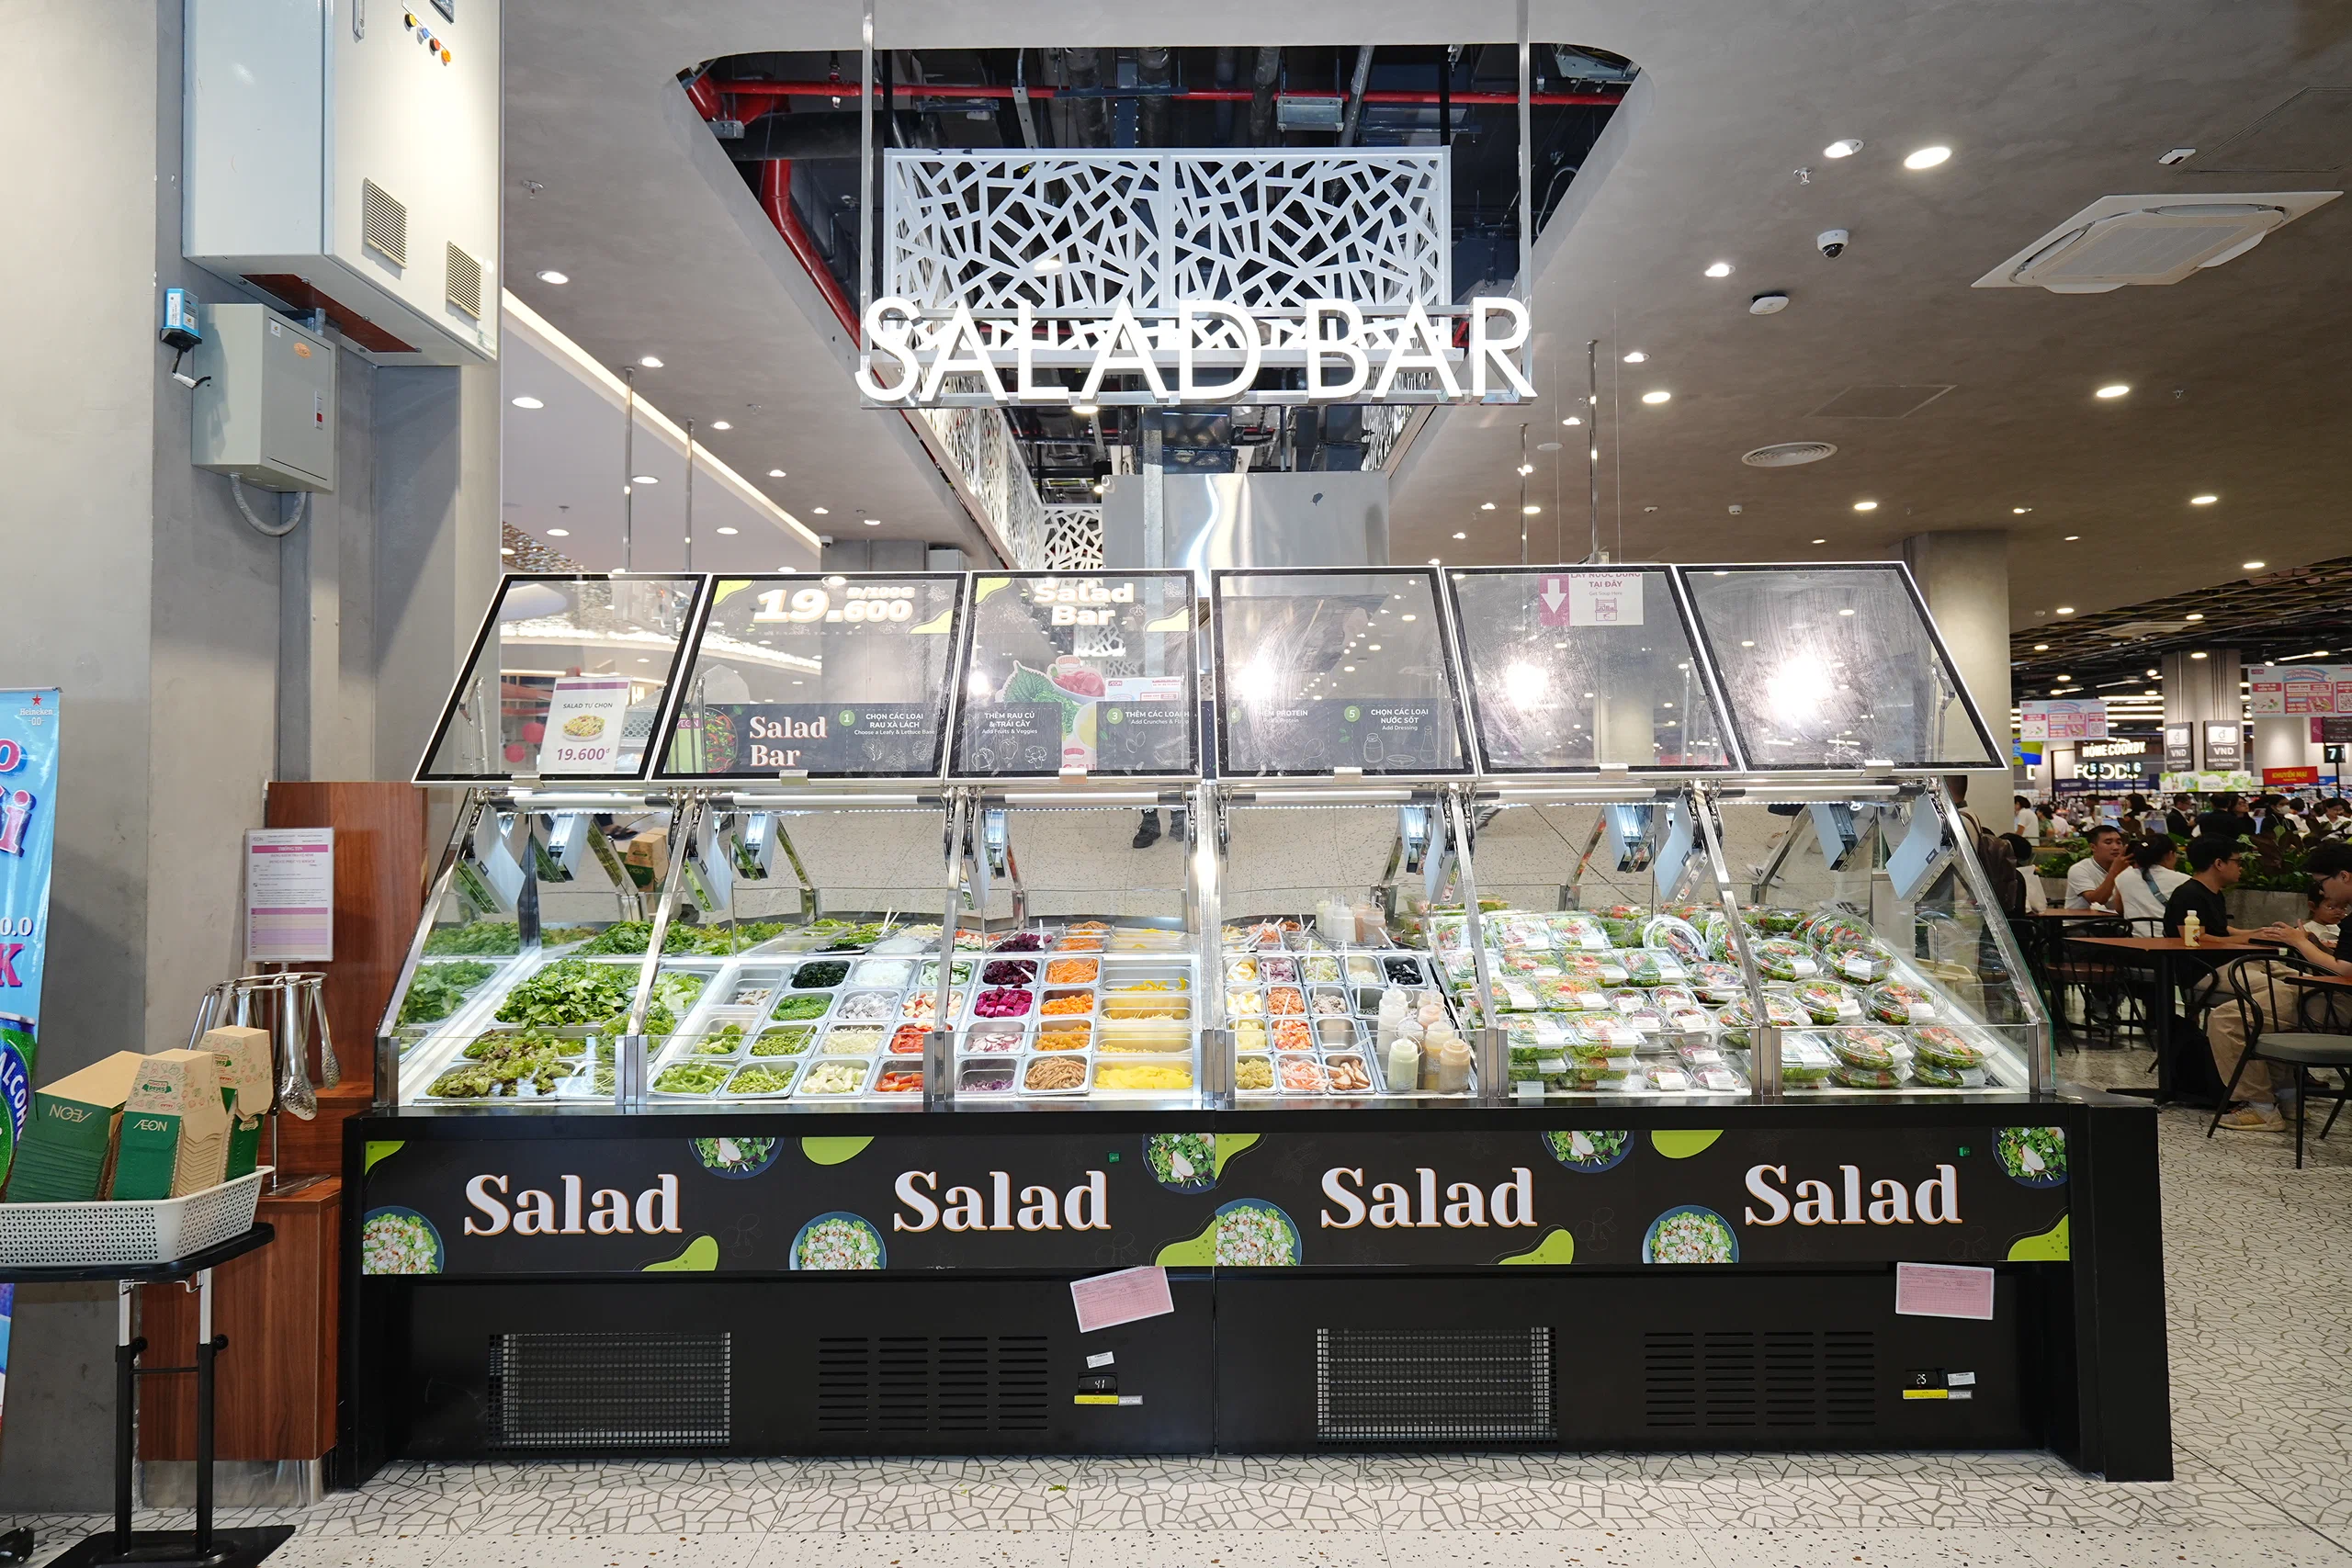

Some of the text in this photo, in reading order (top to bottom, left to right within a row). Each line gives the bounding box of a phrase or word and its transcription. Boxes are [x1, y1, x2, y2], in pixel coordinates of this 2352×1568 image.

[854, 296, 1539, 402] SALAD BAR
[1033, 578, 1134, 604] Salad
[1051, 605, 1116, 626] Bar
[843, 714, 850, 723] 1
[865, 713, 888, 721] CHỌN
[906, 713, 924, 721] LOẠI
[1024, 710, 1035, 718] CỦ
[1112, 712, 1118, 721] 3
[1349, 709, 1355, 718] 5
[1371, 708, 1392, 716] CHỌN
[1410, 708, 1429, 716] LOẠI
[749, 716, 828, 739] Salad
[750, 744, 801, 768] Bar
[2170, 749, 2187, 758] VND
[2213, 747, 2234, 755] VND
[2327, 748, 2337, 760] 7
[2073, 762, 2139, 780] FOOD
[2089, 762, 2097, 773] 5
[2133, 761, 2142, 773] 6
[0, 1052, 28, 1142] LCOH
[893, 1169, 1111, 1233] Salad
[1320, 1167, 1538, 1230] Salad
[1744, 1164, 1963, 1226] Salad
[463, 1173, 683, 1237] Salad
